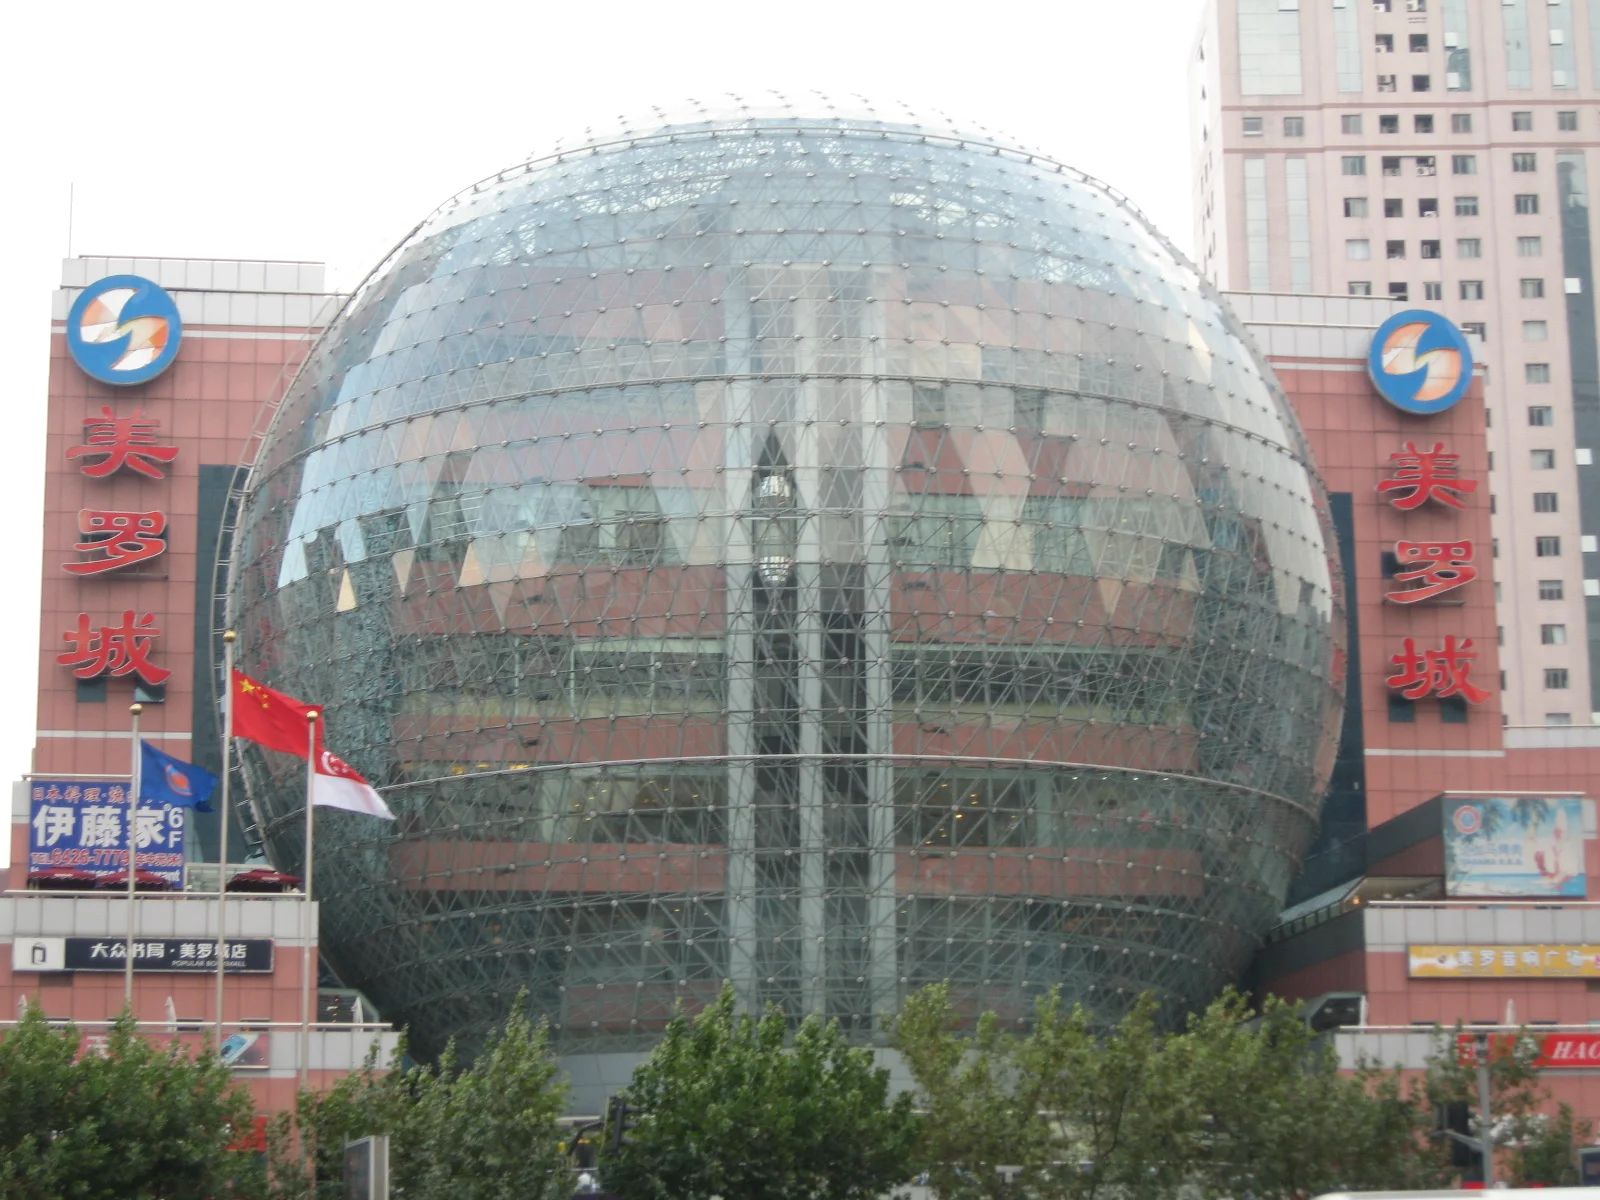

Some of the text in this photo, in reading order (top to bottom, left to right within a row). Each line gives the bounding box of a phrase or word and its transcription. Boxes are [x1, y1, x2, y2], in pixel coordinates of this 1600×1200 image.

[57, 406, 179, 685] 美罗城
[1376, 441, 1493, 704] 美罗城
[32, 804, 166, 849] 伊藤家
